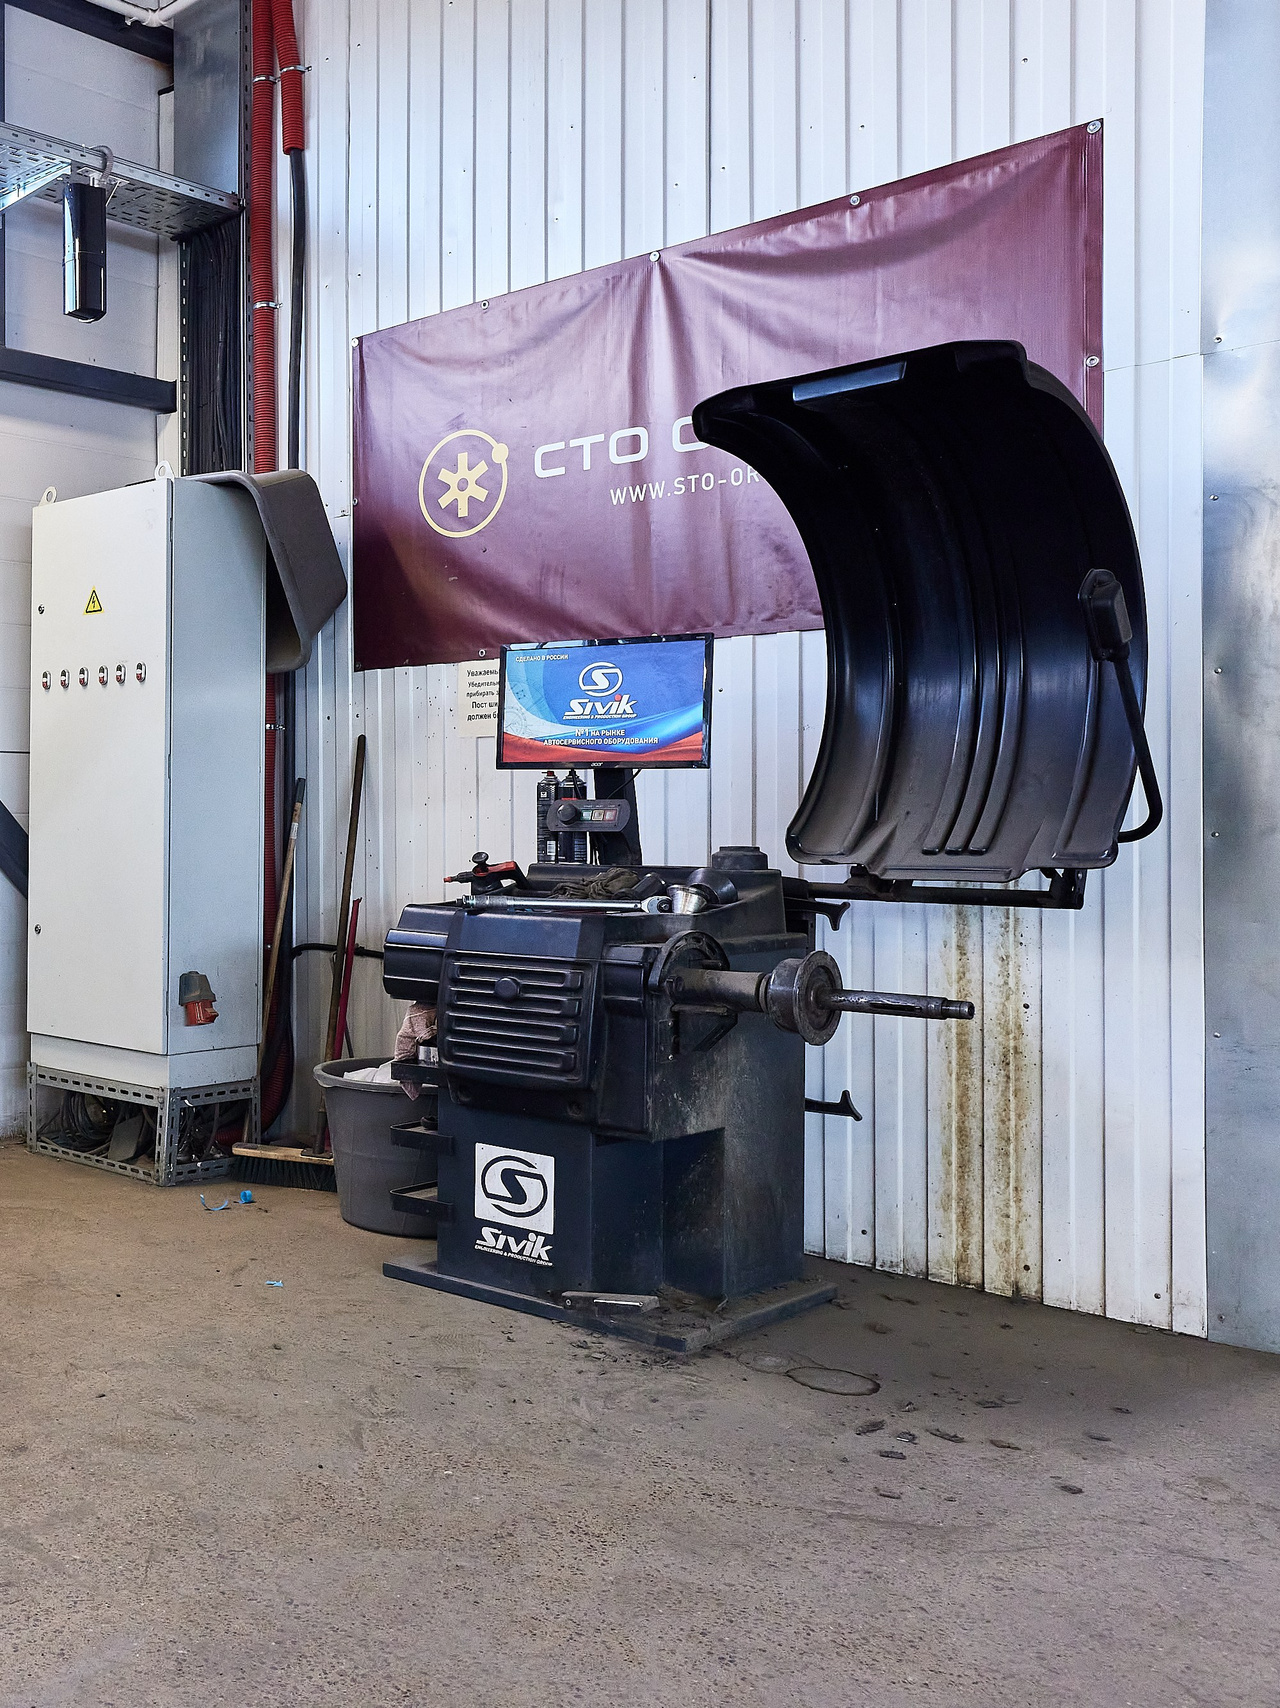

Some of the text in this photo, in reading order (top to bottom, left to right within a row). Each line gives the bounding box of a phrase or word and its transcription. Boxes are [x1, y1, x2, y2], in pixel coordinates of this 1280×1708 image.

[533, 425, 650, 479] СТО
[515, 655, 541, 663] СДЕЛАНО
[546, 653, 569, 661] РОССИИ
[471, 701, 487, 709] Пост
[467, 713, 492, 722] должен
[601, 729, 626, 737] РЫНКЕ
[603, 737, 659, 745] ОБОРУДОВАНИЯ
